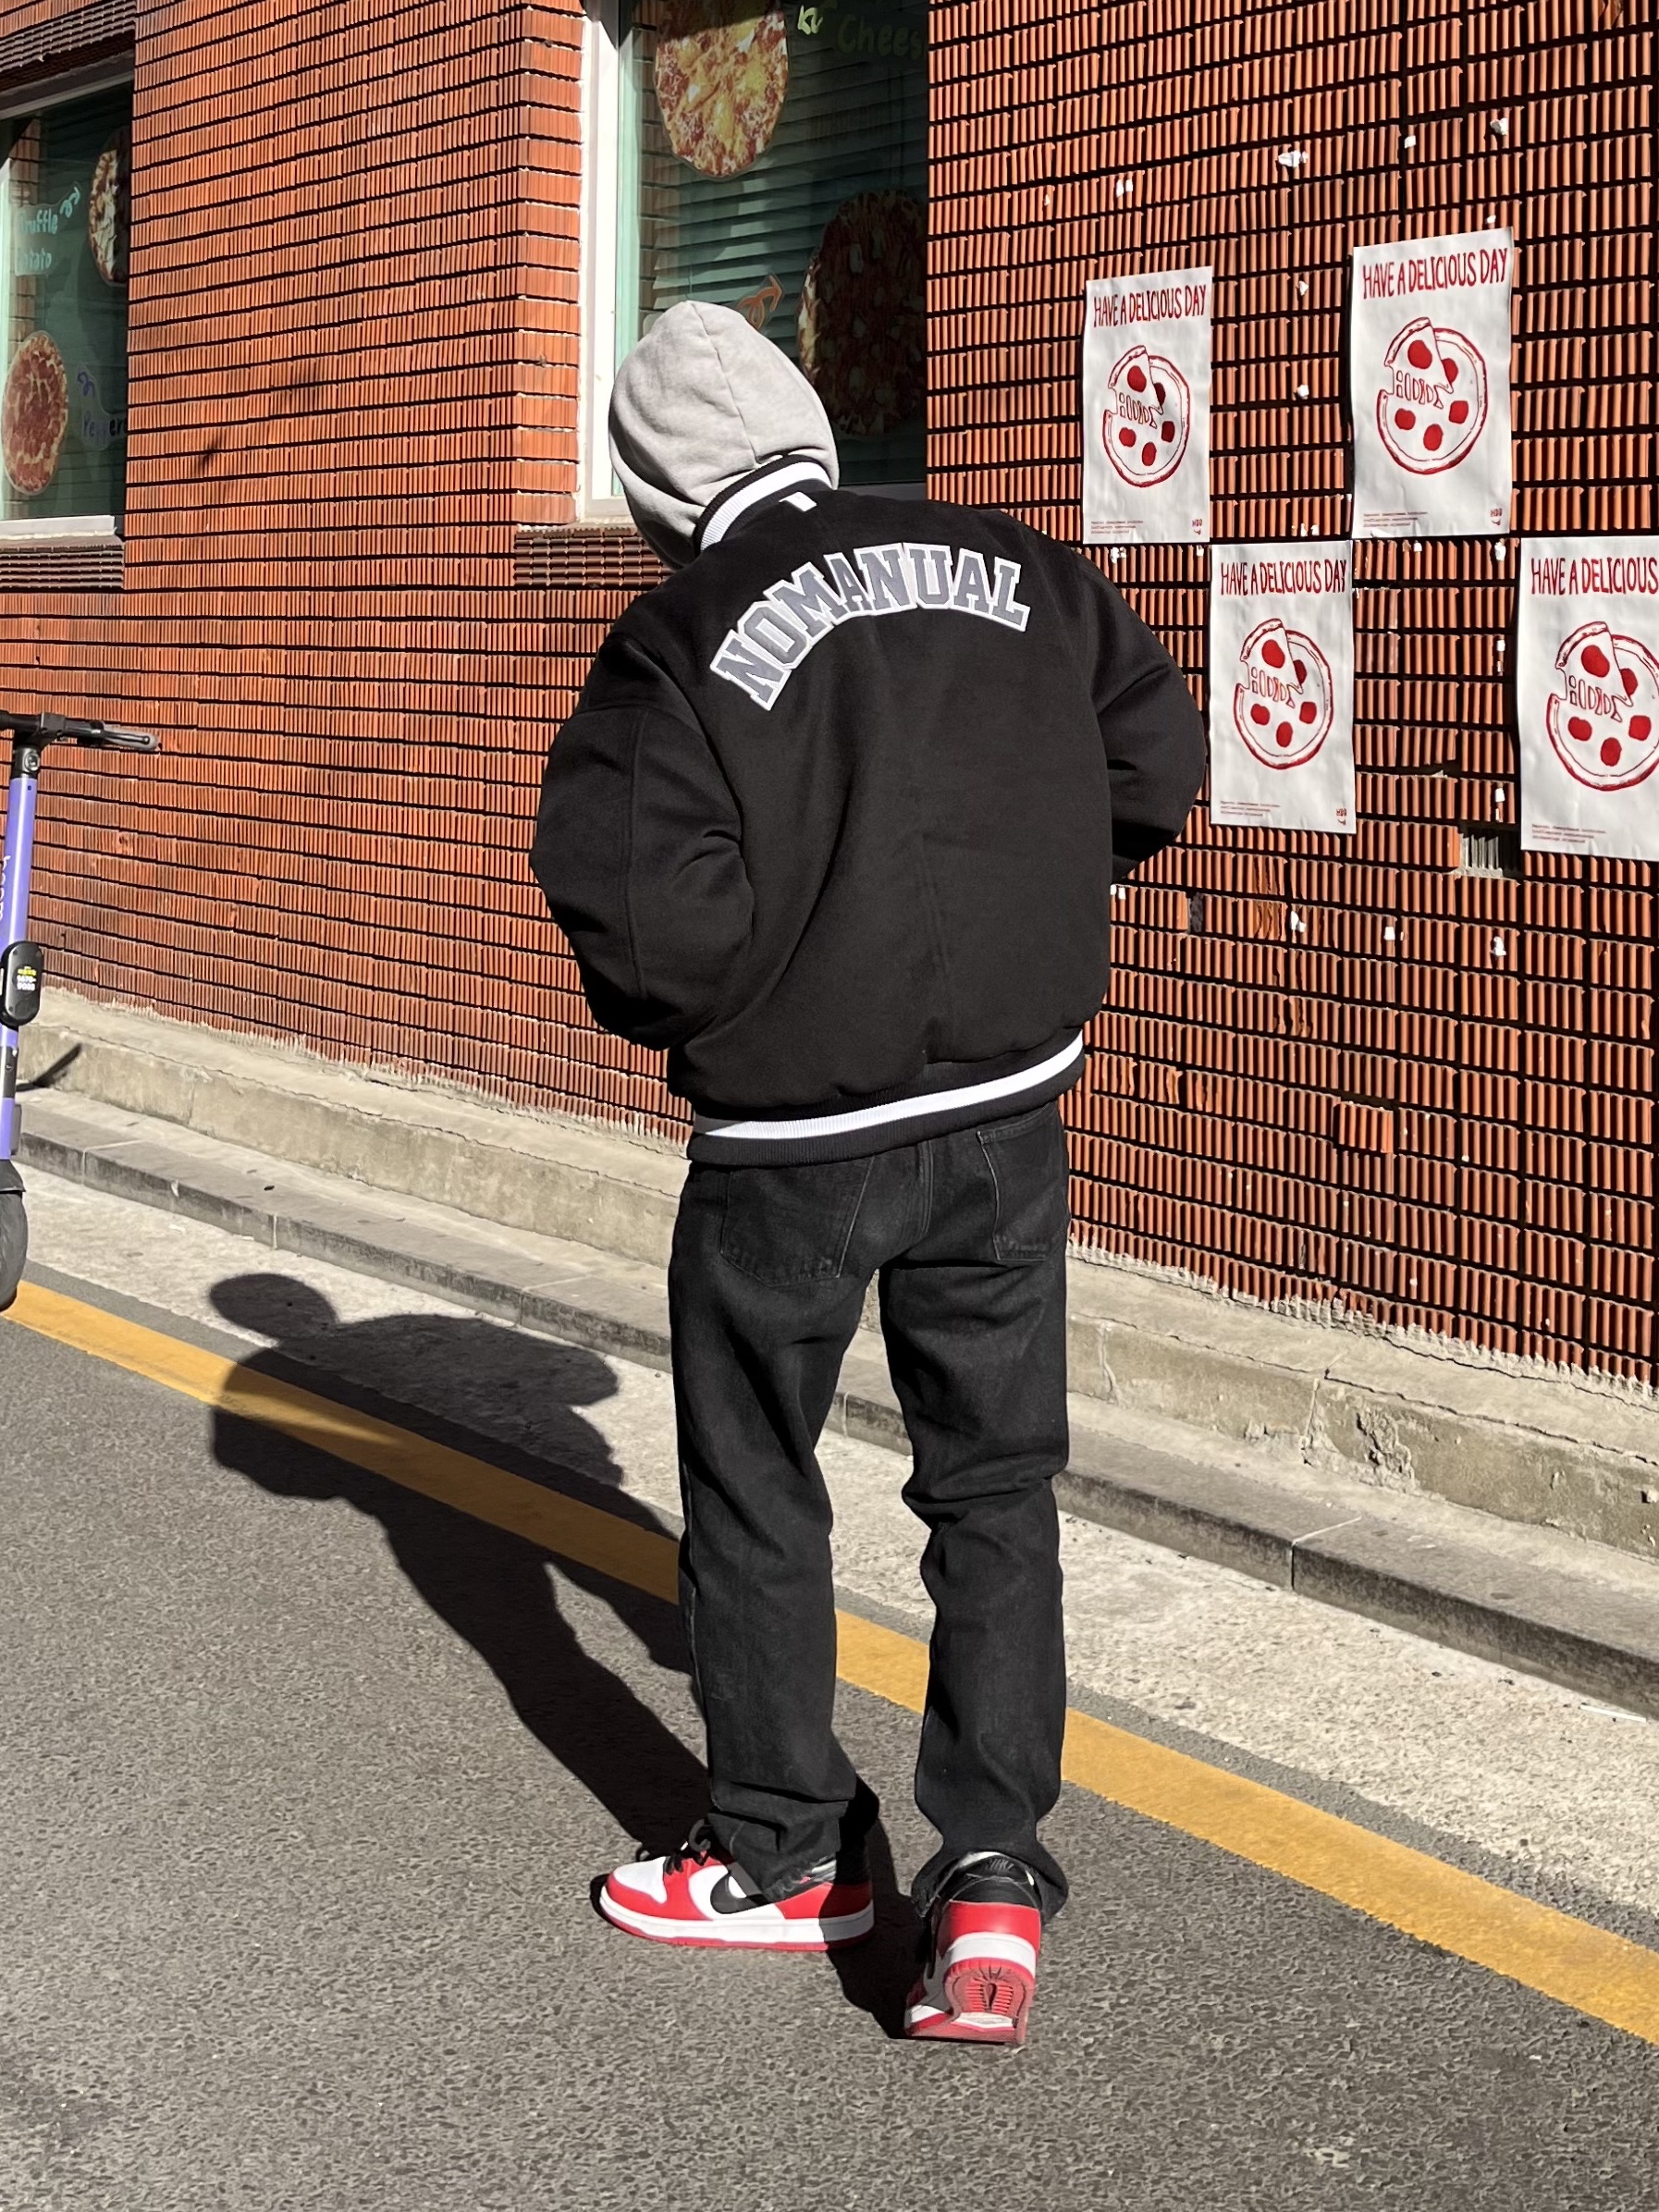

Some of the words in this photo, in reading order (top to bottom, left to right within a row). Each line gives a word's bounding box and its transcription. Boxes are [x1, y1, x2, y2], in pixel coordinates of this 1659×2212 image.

[18, 208, 58, 235] Truffle
[1362, 262, 1395, 300] HAVE
[1397, 263, 1406, 295] A
[1408, 252, 1477, 293] DELICIOUS
[1480, 248, 1507, 284] DAY
[1094, 294, 1118, 327] HAVE
[1120, 295, 1126, 326] A
[1129, 288, 1182, 323] DELICIOUS
[1185, 284, 1206, 316] DAY
[1221, 562, 1247, 596] HAVE
[1250, 563, 1259, 596] A
[1260, 560, 1321, 594] DELICIOUS
[1324, 559, 1346, 593] DAY
[1531, 558, 1566, 596] HAVE
[1569, 559, 1579, 595] A
[1581, 557, 1659, 595] DELICIOUS
[710, 542, 1030, 711] NOMANUAL
